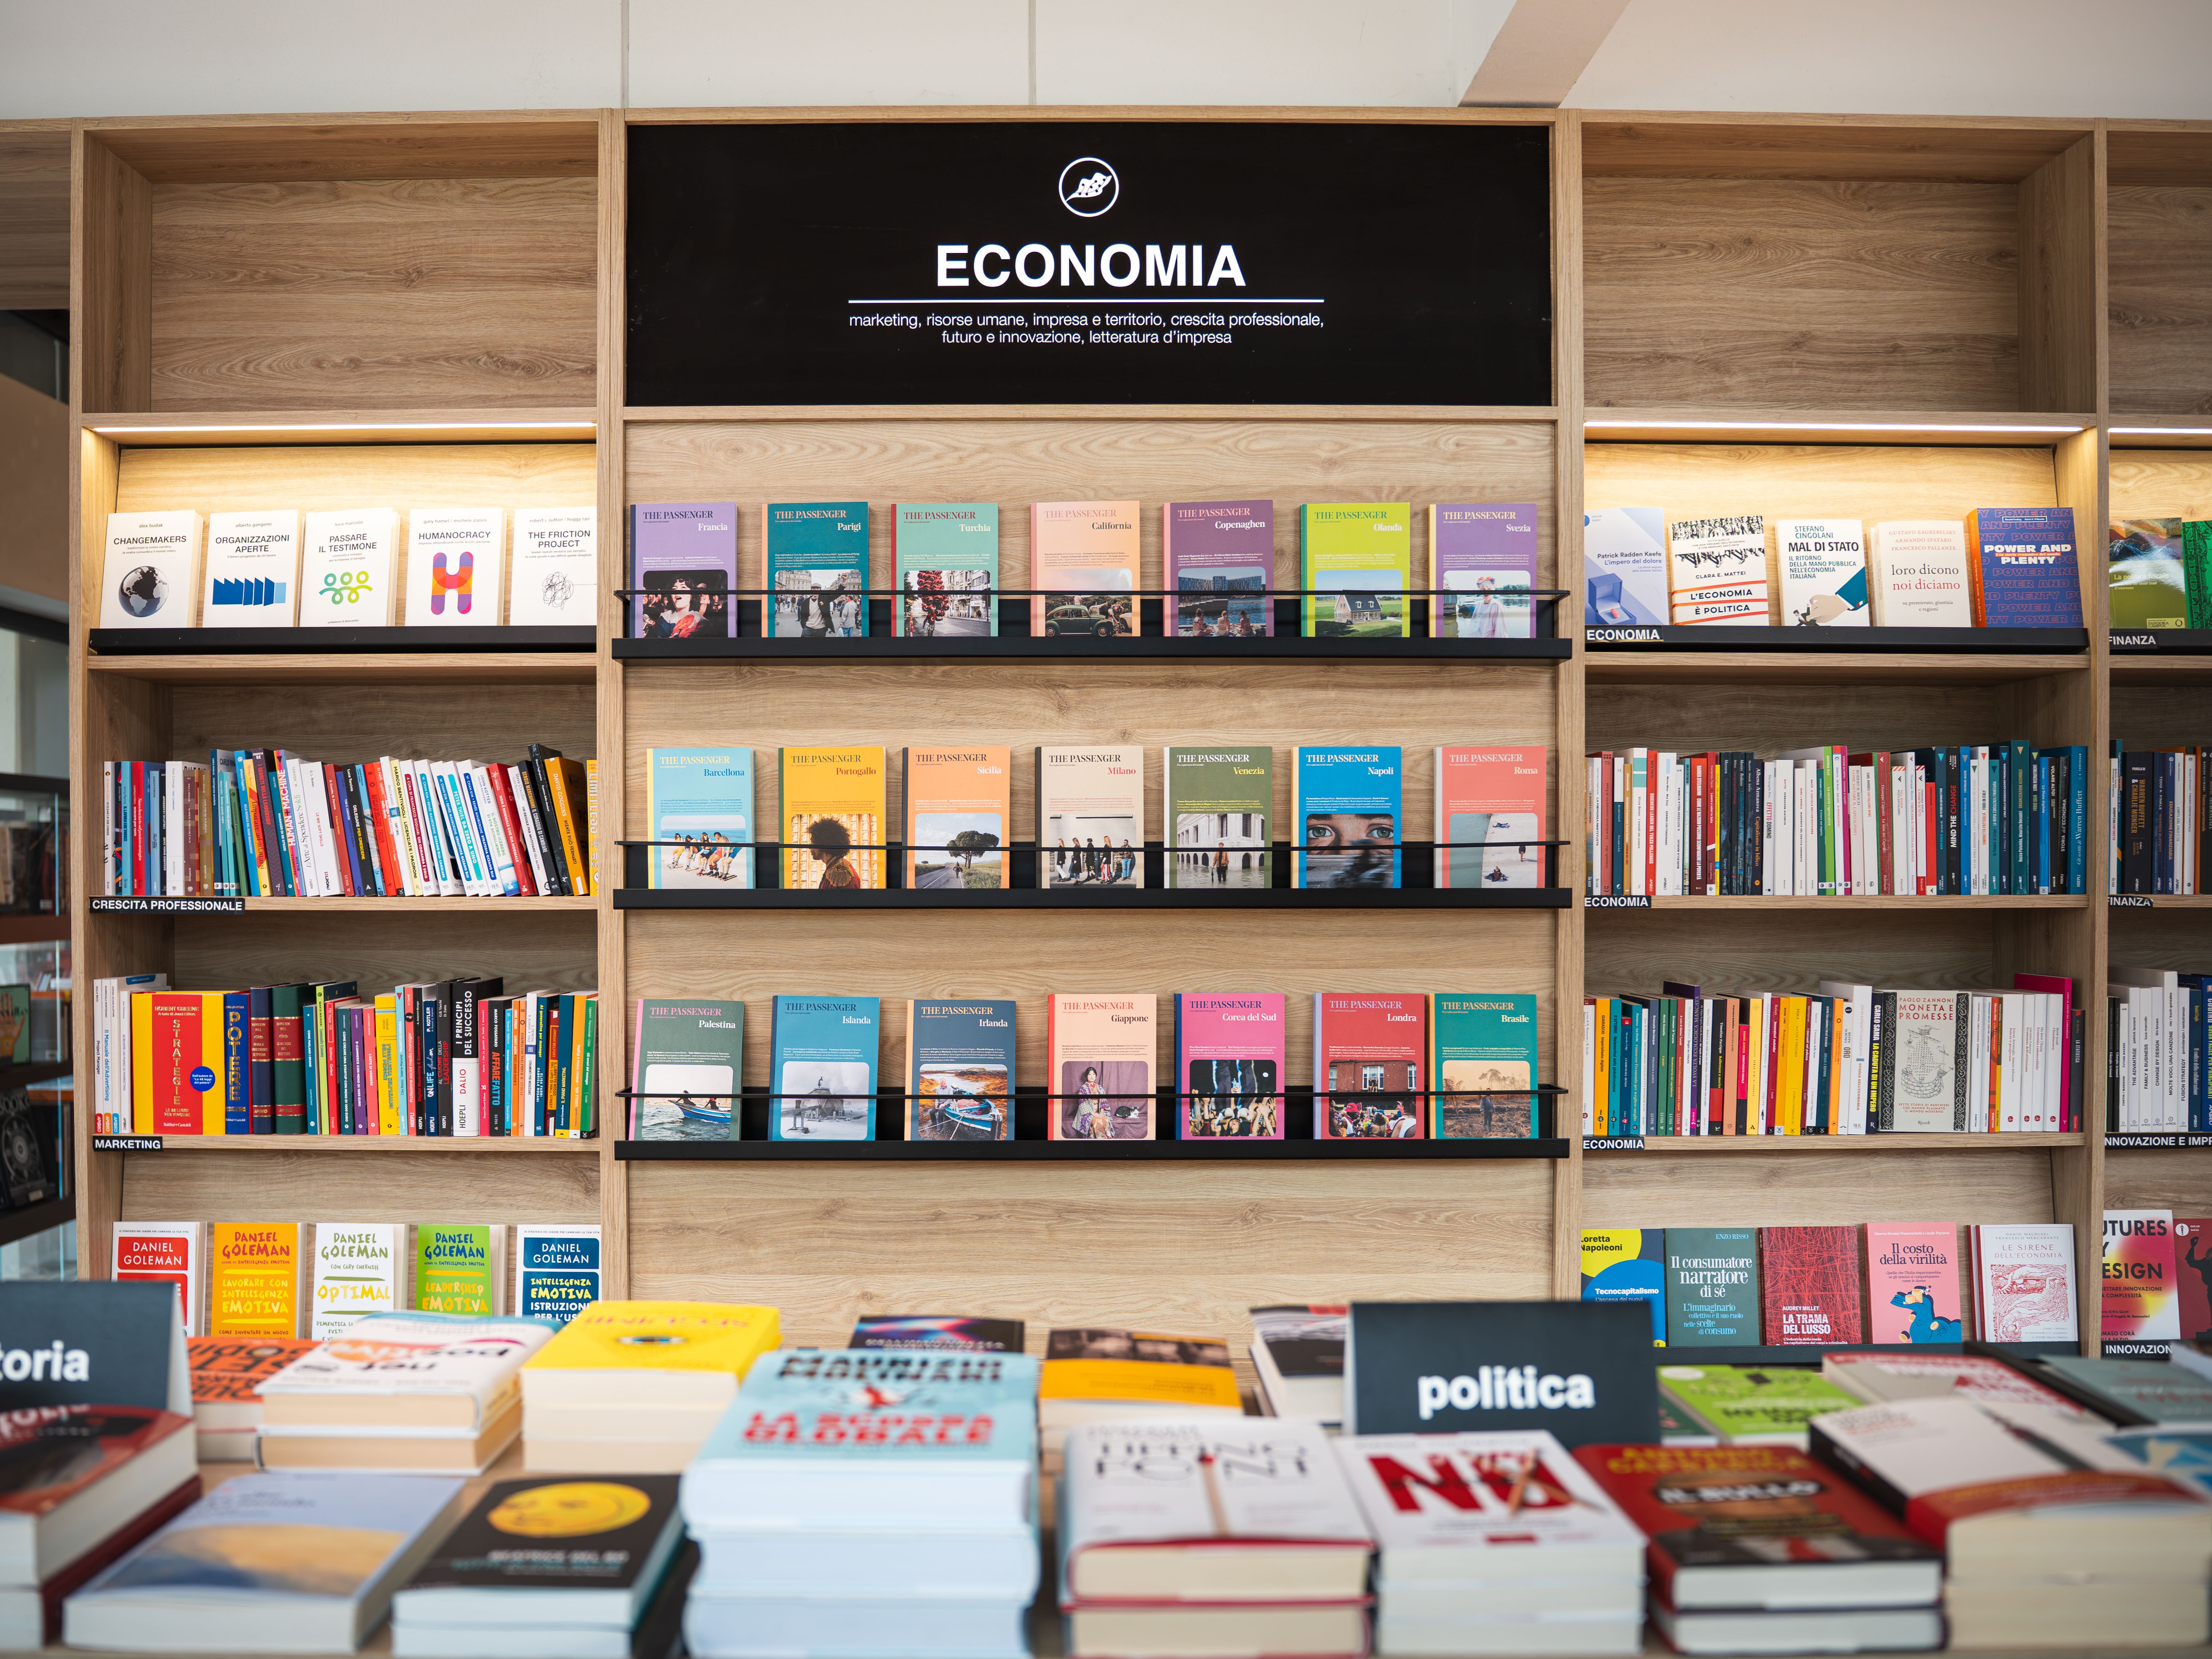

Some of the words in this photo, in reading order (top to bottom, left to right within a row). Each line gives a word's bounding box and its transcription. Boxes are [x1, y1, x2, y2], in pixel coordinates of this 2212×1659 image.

[938, 244, 1246, 287] ECONOMIA
[849, 313, 922, 329] marketing,
[927, 313, 972, 326] risorse
[977, 315, 1028, 327] umane,
[1033, 313, 1088, 328] impresa
[1092, 316, 1101, 326] e
[1105, 312, 1166, 327] territorio,
[1171, 312, 1224, 326] crescita
[1229, 312, 1324, 328] professionale,
[942, 330, 982, 343] futuro
[986, 333, 995, 343] e
[999, 330, 1084, 344] innovazione,
[1089, 330, 1159, 343] letteratura
[1163, 330, 1232, 346] d'impresa
[664, 510, 713, 519] PASSENGER
[1178, 509, 1197, 518] THE
[1199, 507, 1250, 517] PASSENGER
[698, 523, 728, 531] Francia
[837, 523, 861, 532] Parigi
[959, 524, 991, 532] Turchia
[1215, 519, 1265, 531] Copenaghen
[1506, 524, 1531, 532] Svezia
[215, 534, 290, 544] ORGANIZZAZIONI
[329, 534, 367, 543] PASSARE
[419, 531, 491, 540] HUMANOCRACY
[548, 530, 591, 539] FRICTION
[113, 536, 187, 545] CHANGEMAKERS
[538, 540, 580, 548] PROJECT
[328, 542, 377, 552] TESTIMONE
[1788, 542, 1812, 552] MAL
[1814, 542, 1825, 552] DI
[1828, 541, 1859, 551] STATO
[1984, 544, 2036, 553] POWER
[2041, 544, 2071, 552] AND
[2001, 556, 2055, 565] PLENTY
[1891, 565, 1915, 576] loro
[1919, 563, 1959, 575] dicono
[1893, 580, 1912, 591] noi
[1914, 578, 1960, 590] diciamo
[1690, 589, 1753, 600] L'ECONOMIA
[1695, 606, 1701, 615] È
[1704, 604, 1750, 614] POLITICA
[1587, 629, 1660, 641] ECONOMIA
[791, 755, 810, 763] THE
[703, 768, 744, 777] Barcellona
[836, 767, 876, 777] Portogallo
[977, 766, 1002, 774] Sicilia
[1233, 767, 1265, 775] Venezia
[1367, 767, 1394, 776] Napoli
[277, 769, 291, 809] MACHINE
[285, 816, 296, 847] HUMAN
[92, 900, 146, 910] CRESCITA
[151, 900, 242, 911] PROFESSIONALE
[1584, 896, 1648, 907] ECONOMIA
[942, 1007, 993, 1015] PASSENGER
[842, 1016, 871, 1025] Islanda
[1111, 1014, 1148, 1024] Giappone
[1261, 1013, 1277, 1021] Sud
[1387, 1013, 1417, 1022] Londra
[698, 1019, 736, 1029] Palestina
[979, 1018, 1008, 1027] Irlanda
[172, 1019, 181, 1105] STRATEGIE
[491, 1052, 500, 1106] AFFAREFATTO
[95, 1139, 161, 1149] MARKETING
[1583, 1139, 1644, 1149] ECONOMIA
[2104, 1136, 2175, 1146] NNOVAZIONE
[2103, 1220, 2167, 1236] TURES
[234, 1231, 277, 1242] DANIEL
[133, 1242, 174, 1252] DANIEL
[222, 1244, 290, 1259] GOLEMAN
[1581, 1244, 1623, 1253] Napoleoni
[1891, 1243, 1901, 1254] Il
[1903, 1244, 1934, 1254] costo
[123, 1255, 181, 1266] GOLEMAN
[1670, 1256, 1680, 1268] Il
[1682, 1257, 1752, 1268] consumatore
[1880, 1254, 1907, 1265] della
[1909, 1253, 1948, 1264] virilità
[2103, 1263, 2163, 1279] ESIGN
[1680, 1270, 1748, 1284] narratore
[223, 1278, 264, 1288] LAVORARE
[270, 1279, 288, 1287] CON
[317, 1284, 391, 1303] OPTIMAL
[425, 1282, 484, 1296] LEADERSHIP
[1700, 1285, 1713, 1298] di
[1714, 1286, 1726, 1298] sé
[222, 1290, 289, 1299] INTELLIGENZA
[222, 1300, 289, 1314] EMOTIVA
[422, 1297, 489, 1312] EMOTIVA
[1783, 1314, 1794, 1324] LA
[1797, 1314, 1828, 1324] TRAMA
[1783, 1324, 1799, 1334] DEL
[1801, 1324, 1831, 1334] LUSSO
[2106, 1345, 2172, 1354] INNOVAZION
[0, 1340, 90, 1381] oria
[1417, 1365, 1596, 1421] politica
